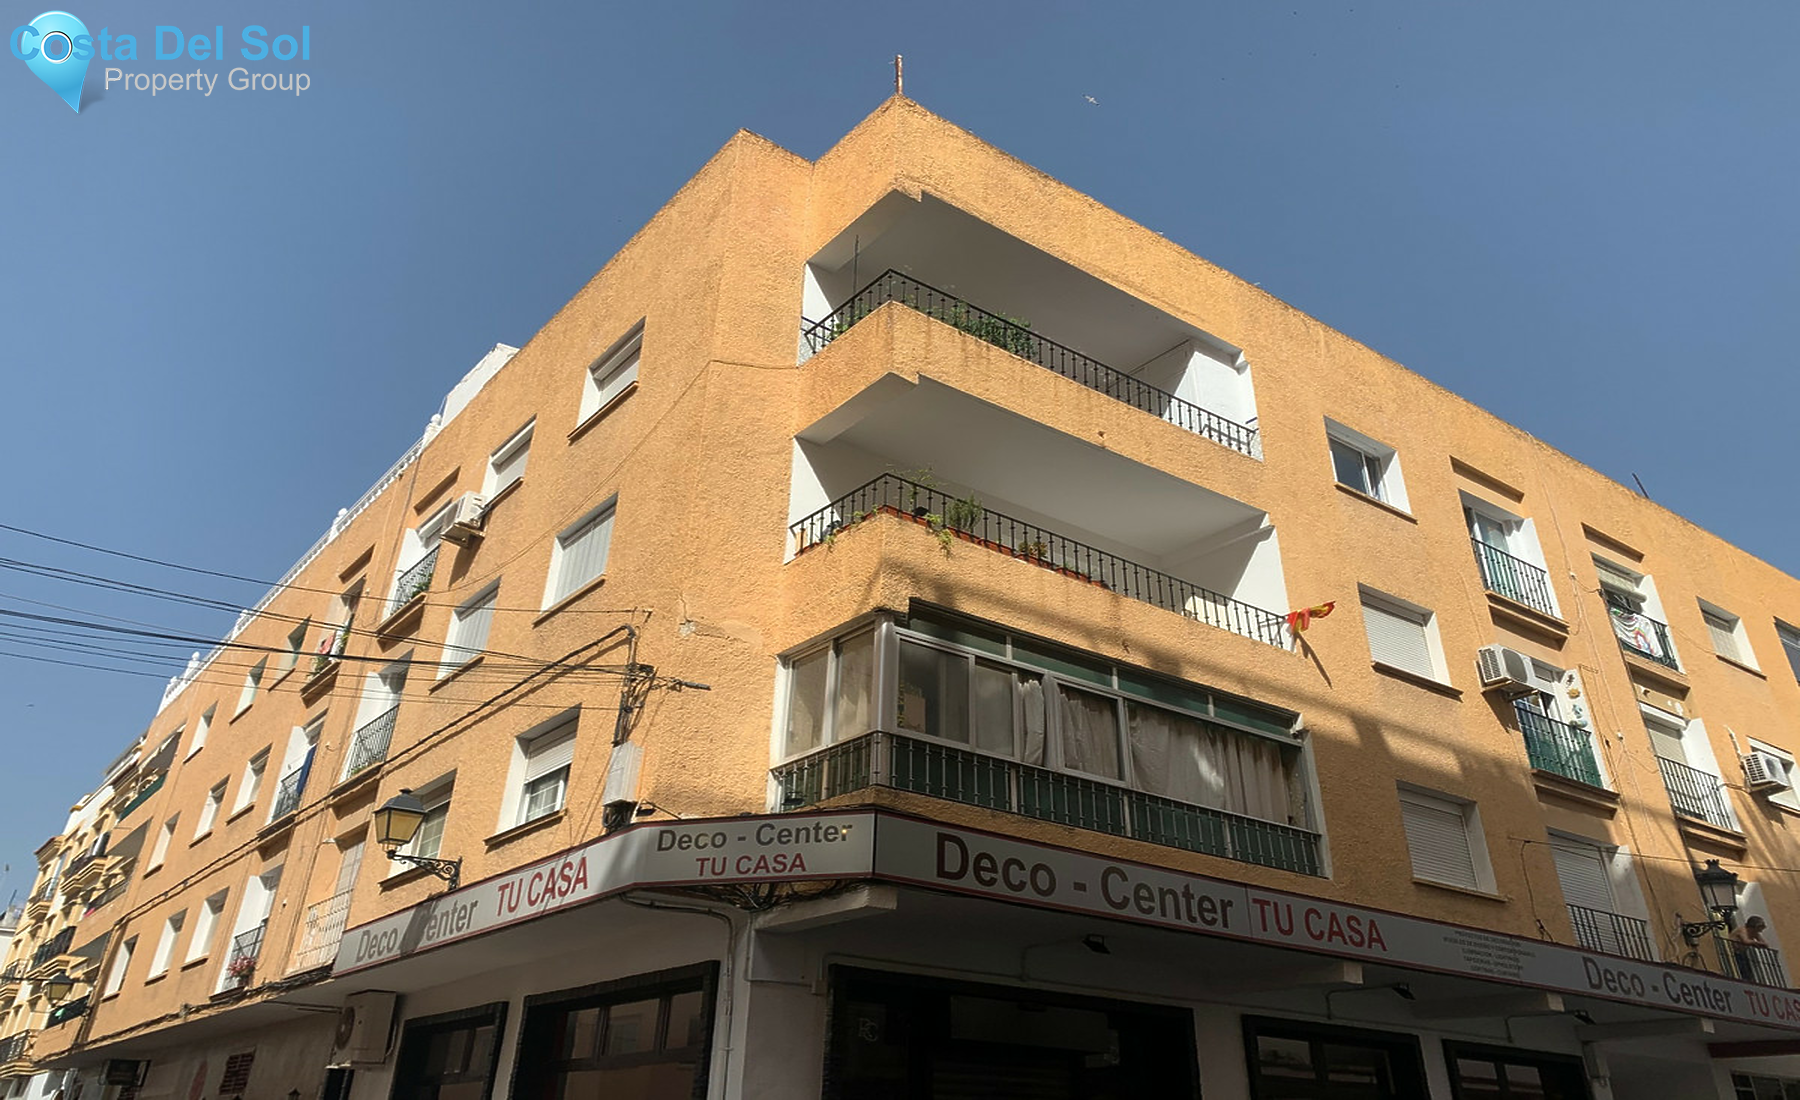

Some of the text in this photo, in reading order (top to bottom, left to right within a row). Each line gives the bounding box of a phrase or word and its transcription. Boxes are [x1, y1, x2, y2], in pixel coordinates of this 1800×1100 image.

[656, 829, 727, 852] Deco
[755, 821, 853, 846] Center
[695, 853, 807, 876] TU CASA
[355, 926, 399, 963] Deco
[497, 878, 523, 917] TU
[527, 856, 589, 907] CASA
[935, 831, 1057, 897] Deco
[1100, 866, 1233, 929] Center
[1251, 898, 1294, 936] TU
[1304, 907, 1388, 952] CASA
[1581, 955, 1645, 997] Deco
[1662, 971, 1733, 1013] Center
[1744, 990, 1769, 1017] TU
